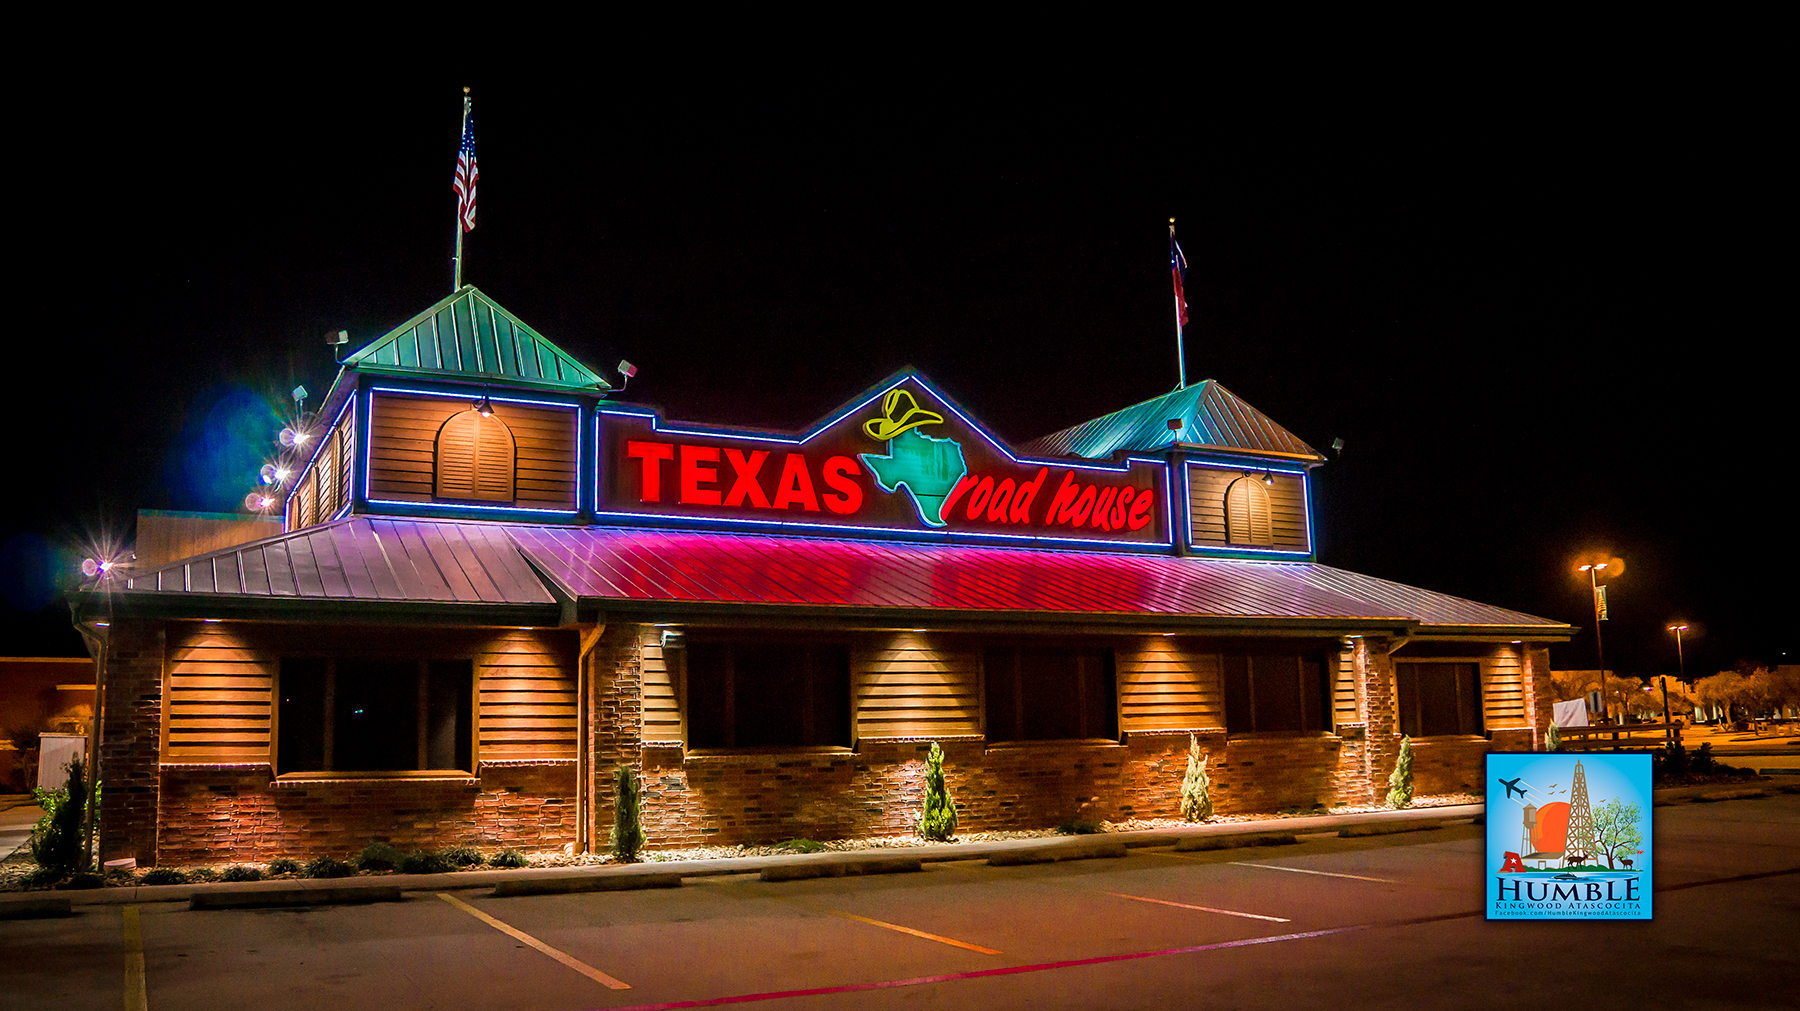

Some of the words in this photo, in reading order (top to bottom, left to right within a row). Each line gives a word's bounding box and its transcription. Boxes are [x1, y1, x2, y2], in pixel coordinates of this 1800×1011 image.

[627, 441, 864, 515] TEXAS
[940, 467, 1047, 521] road
[1045, 471, 1154, 530] house
